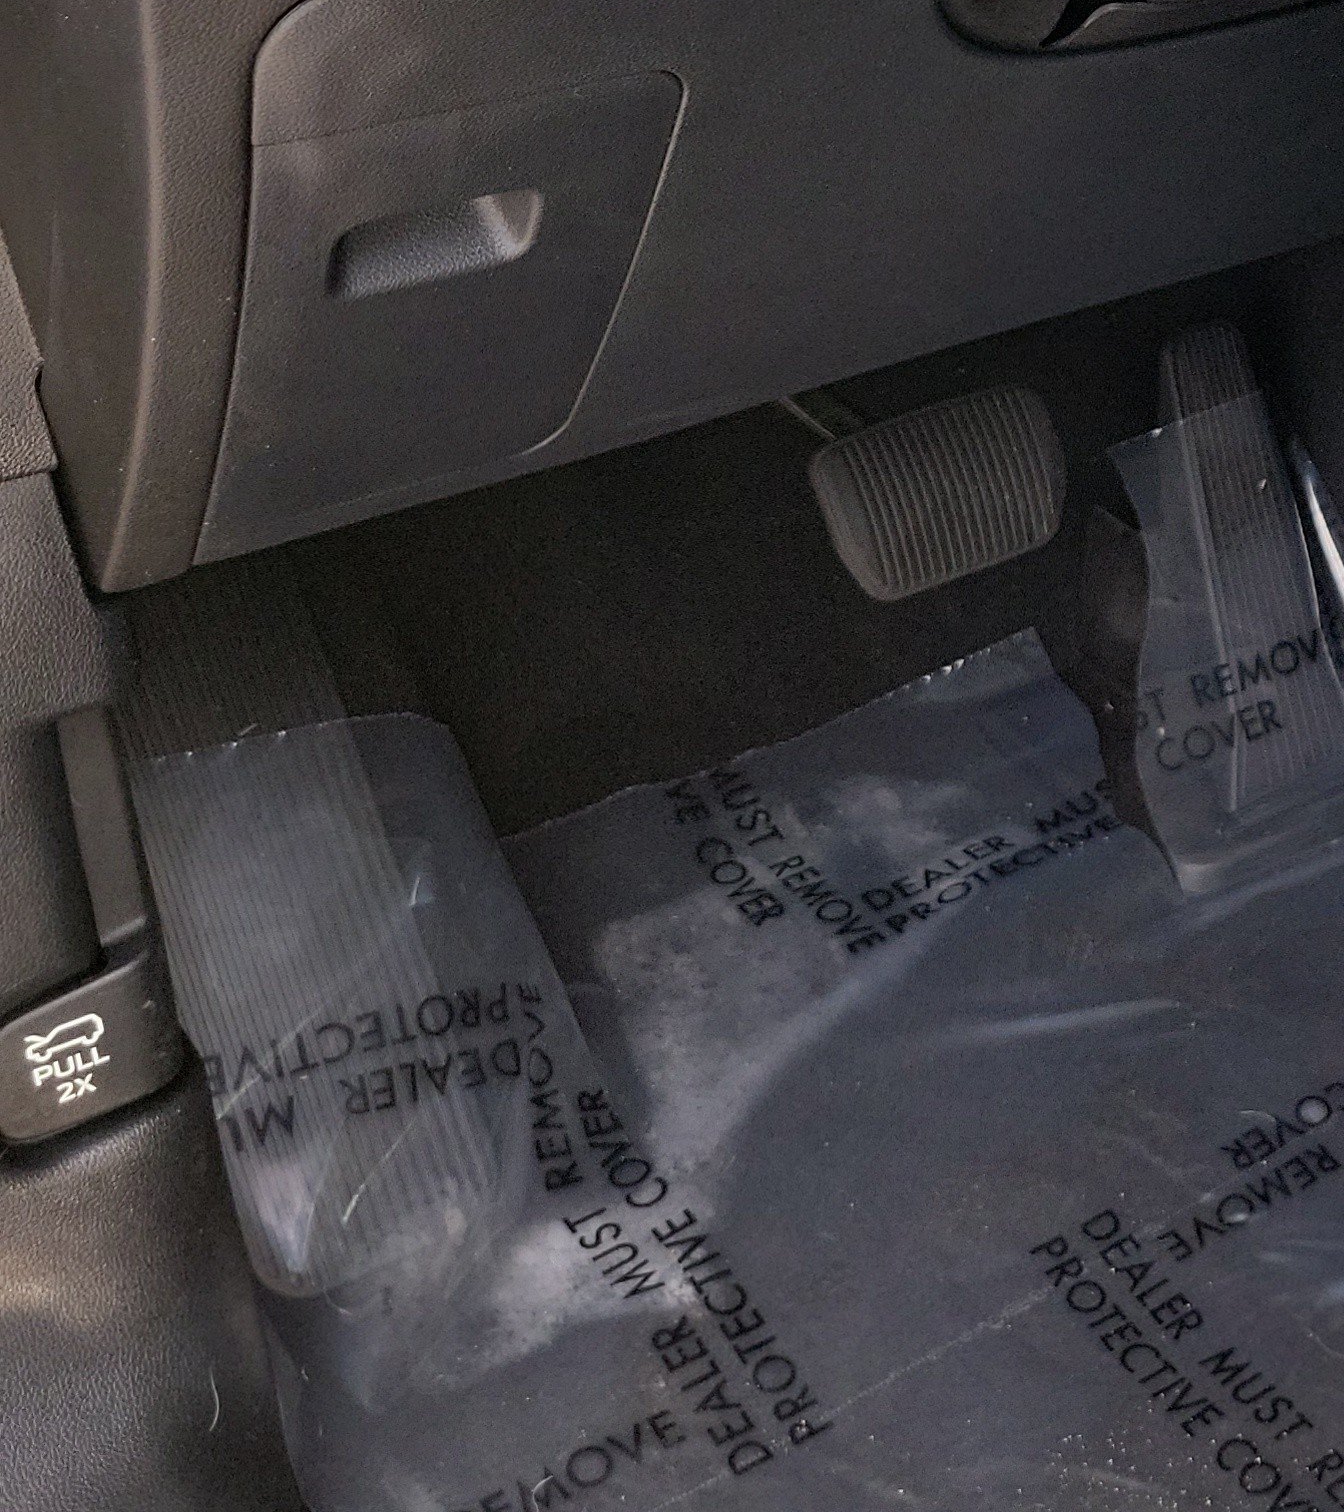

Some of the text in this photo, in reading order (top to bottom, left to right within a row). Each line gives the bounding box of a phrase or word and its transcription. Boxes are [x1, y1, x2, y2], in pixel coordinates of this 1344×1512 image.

[1157, 699, 1283, 770] COVER
[696, 838, 785, 927] COVER
[769, 854, 886, 954] REMOVE
[861, 835, 1015, 912] DEALER
[32, 1046, 111, 1087] PULL
[56, 1072, 98, 1104] 2X
[338, 1037, 522, 1115] DEALER
[518, 983, 775, 1476] DEALER MUST REMOVE
[1155, 1143, 1342, 1263] REMOVE
[577, 1086, 834, 1447] PROTECTIVE COVER
[1028, 1234, 1226, 1437] PROTECTIVE
[1080, 1208, 1204, 1341] DEALER
[1198, 1346, 1314, 1440] MUST
